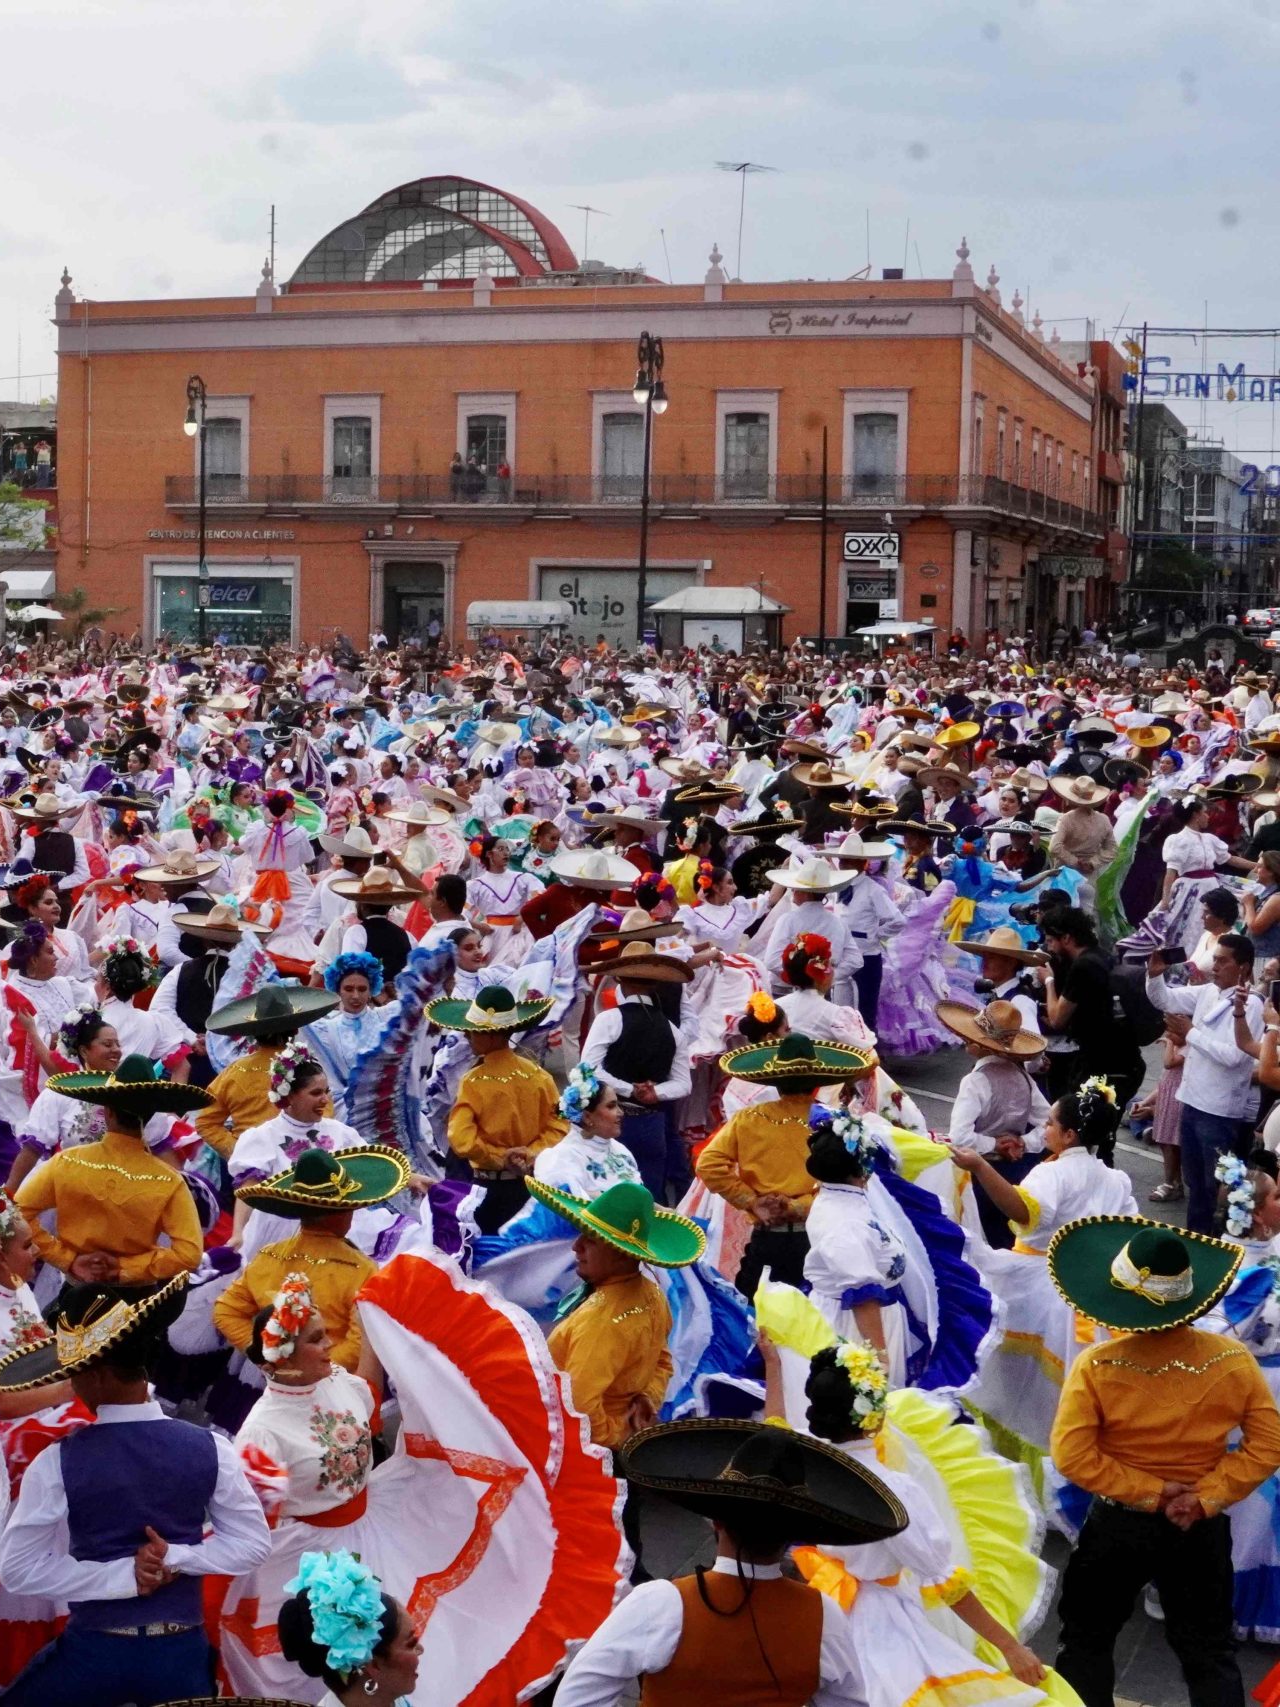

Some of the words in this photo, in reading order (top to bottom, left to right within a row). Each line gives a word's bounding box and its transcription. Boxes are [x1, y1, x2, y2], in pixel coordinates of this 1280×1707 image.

[842, 312, 913, 329] Imperial
[184, 530, 195, 538] DE
[252, 530, 294, 539] CLIENTES
[846, 537, 897, 556] OXXO
[559, 578, 579, 598] el
